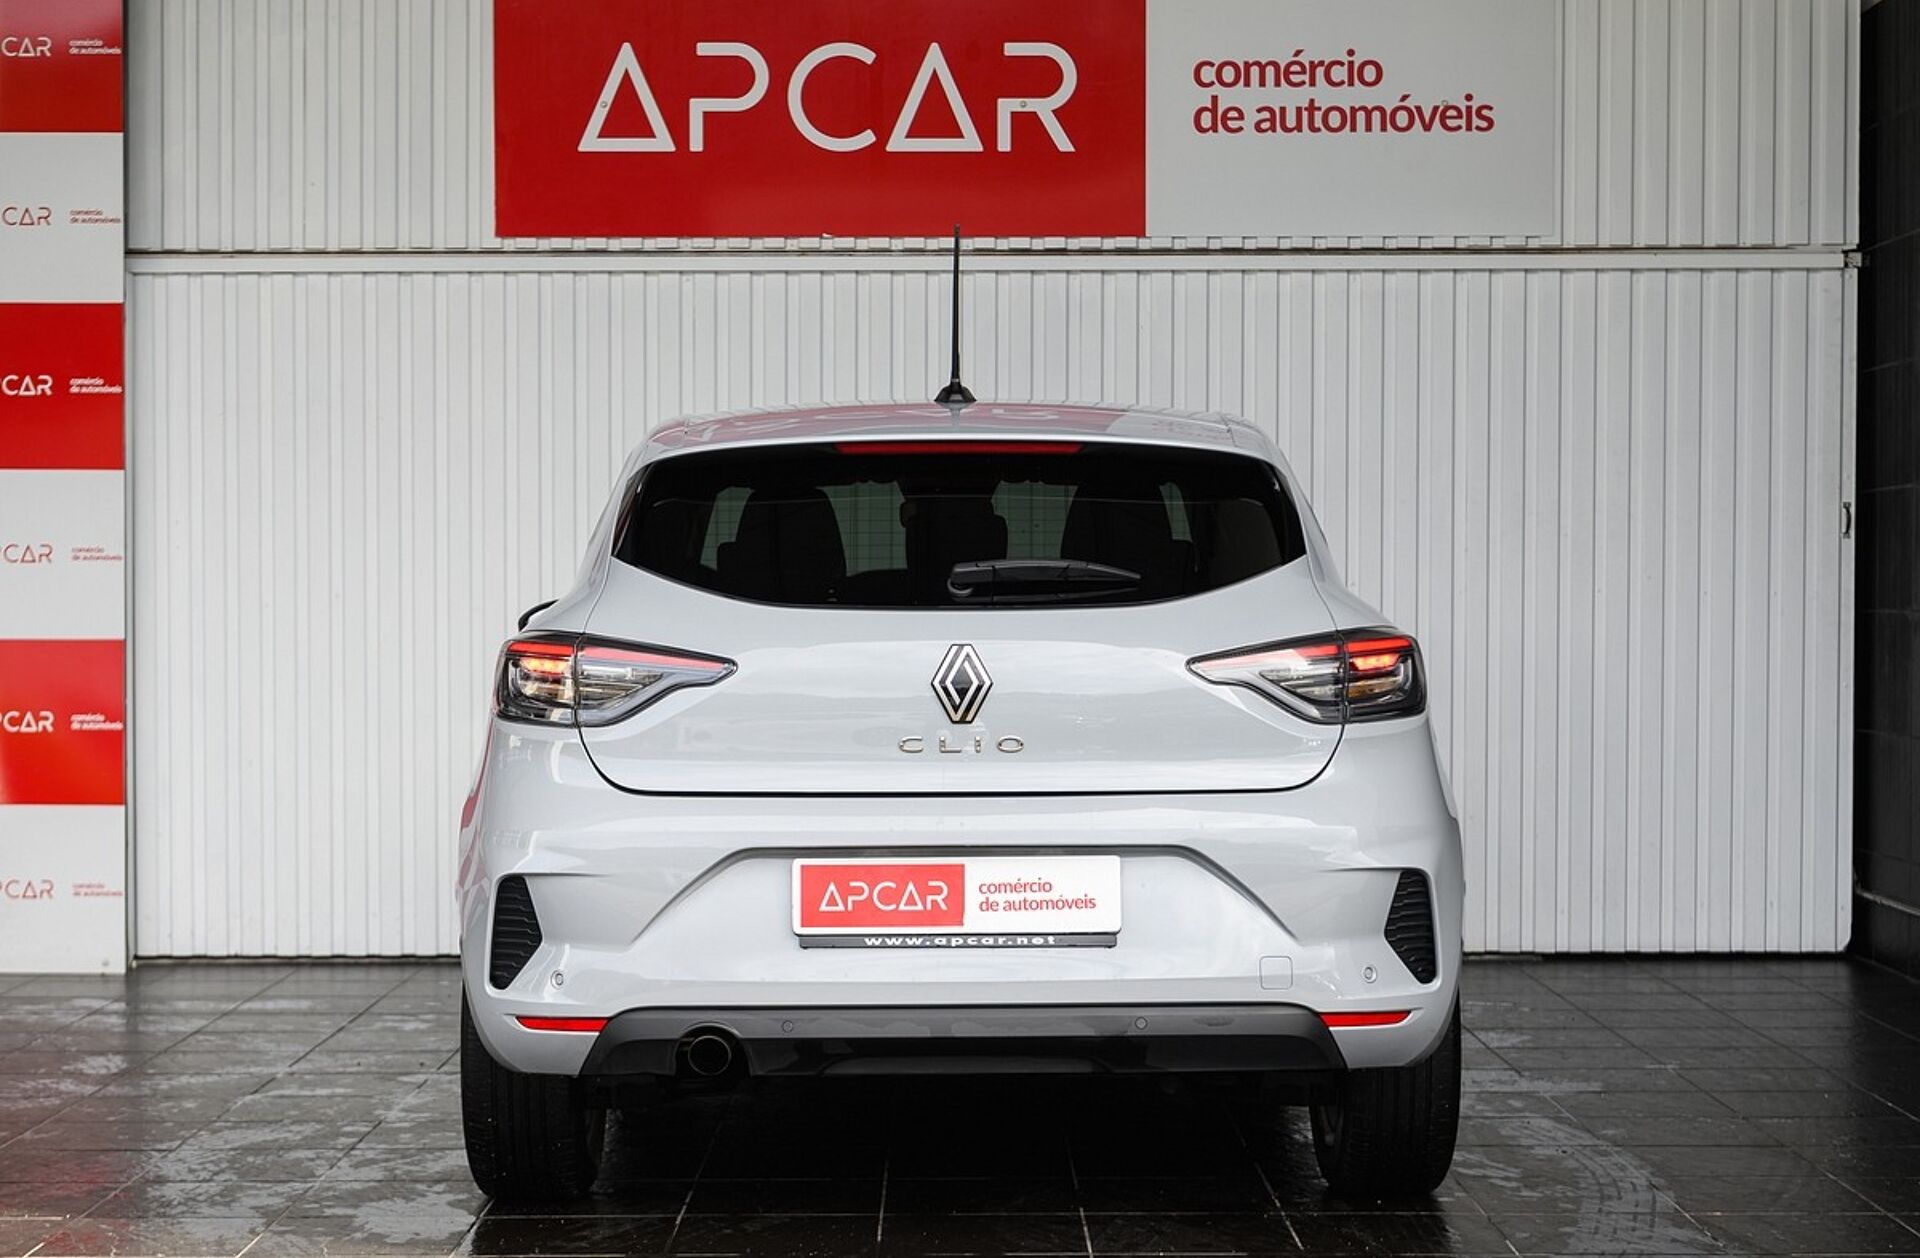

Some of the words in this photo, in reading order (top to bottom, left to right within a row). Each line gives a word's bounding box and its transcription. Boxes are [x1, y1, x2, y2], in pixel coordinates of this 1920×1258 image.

[1193, 49, 1383, 88] comércio
[577, 42, 1078, 152] APCAR
[1193, 95, 1245, 133] de
[1254, 93, 1495, 133] automóveis
[0, 544, 53, 563] CAR
[0, 710, 54, 732] CAR
[898, 735, 1025, 754] CLIO
[0, 879, 54, 899] CAR
[818, 880, 949, 912] APCAR
[978, 877, 1053, 895] comércio
[978, 896, 999, 912] de
[1002, 894, 1097, 912] automóveis
[864, 935, 1056, 947] www.apcar.net
